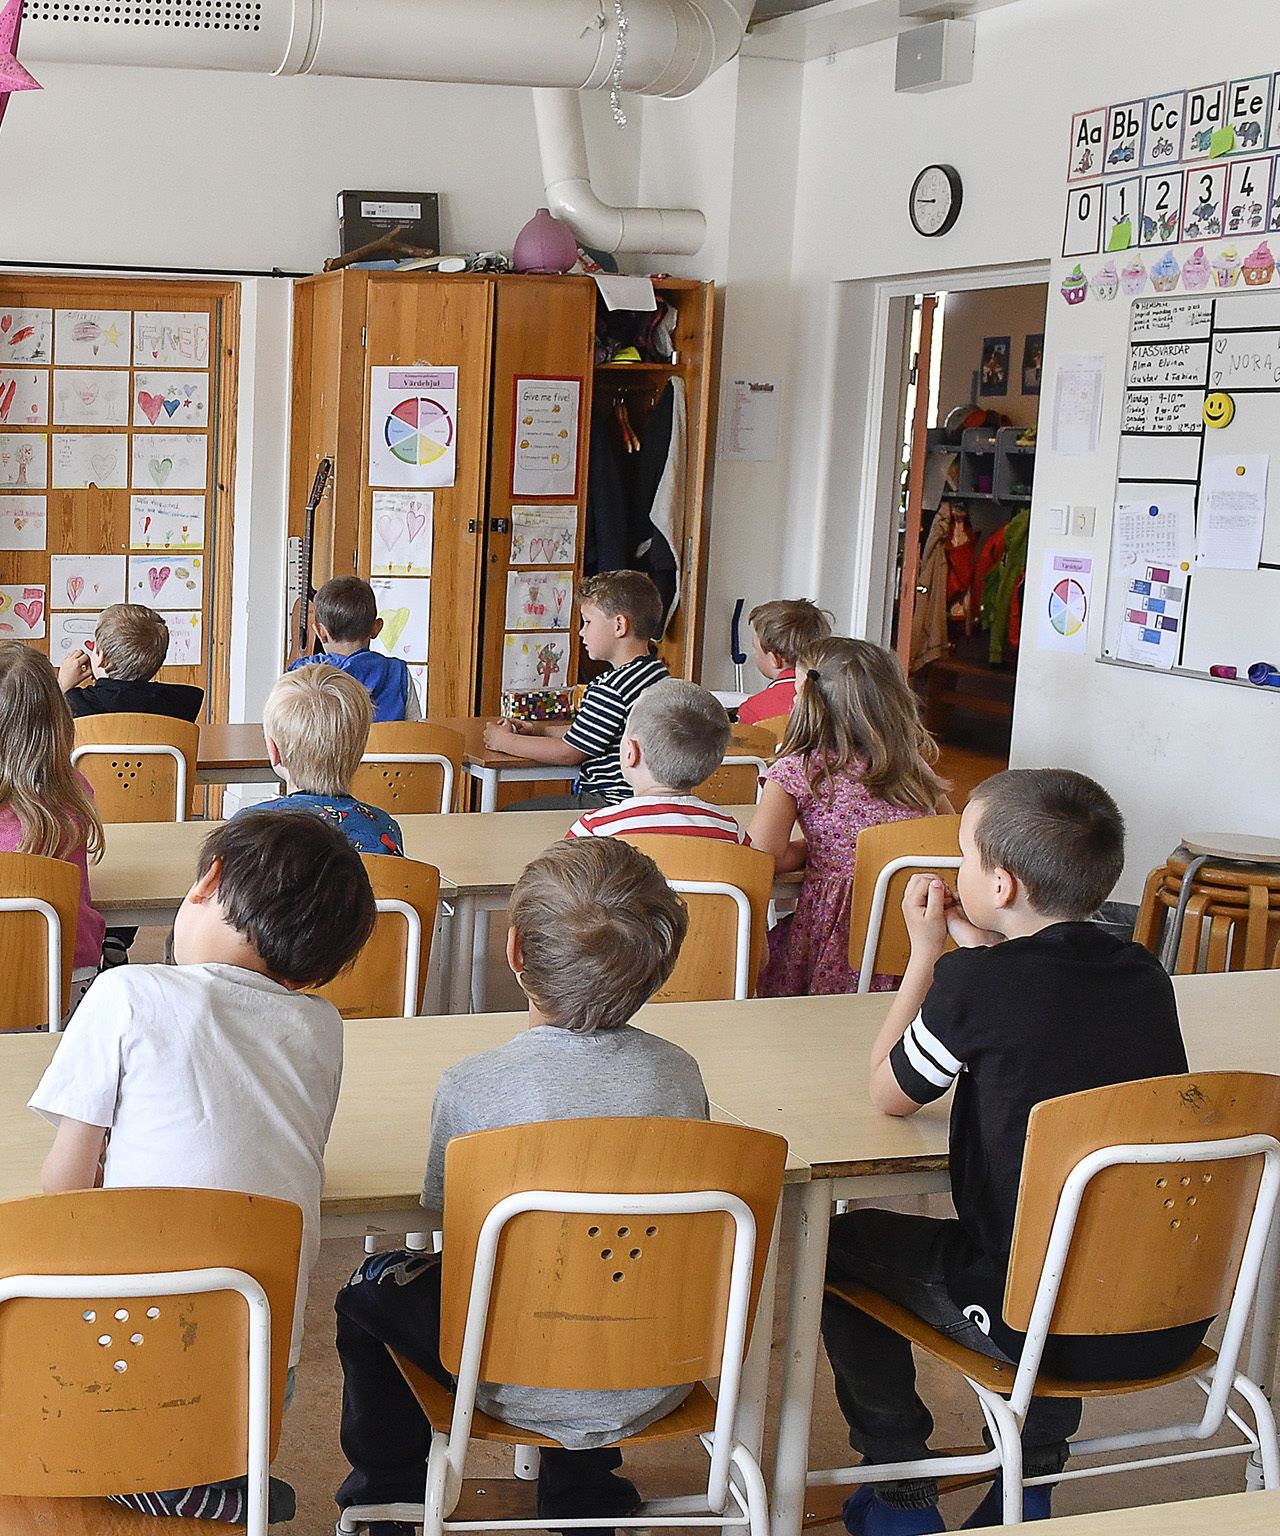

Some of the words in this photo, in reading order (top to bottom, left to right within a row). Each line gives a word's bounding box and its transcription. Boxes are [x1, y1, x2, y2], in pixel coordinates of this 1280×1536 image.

[1076, 118, 1102, 147] Aa
[1112, 109, 1139, 140] Bb
[1151, 103, 1178, 131] Cc
[1190, 90, 1221, 126] Dd
[1233, 85, 1263, 117] Ee
[1078, 193, 1091, 221] 0
[1119, 187, 1125, 215] 1
[1155, 180, 1170, 211] 2
[1199, 174, 1213, 204] 3
[1240, 166, 1254, 197] 4
[1229, 354, 1272, 375] NORA
[403, 379, 440, 388] Värdehjul
[523, 392, 539, 401] Give
[554, 392, 570, 402] five!
